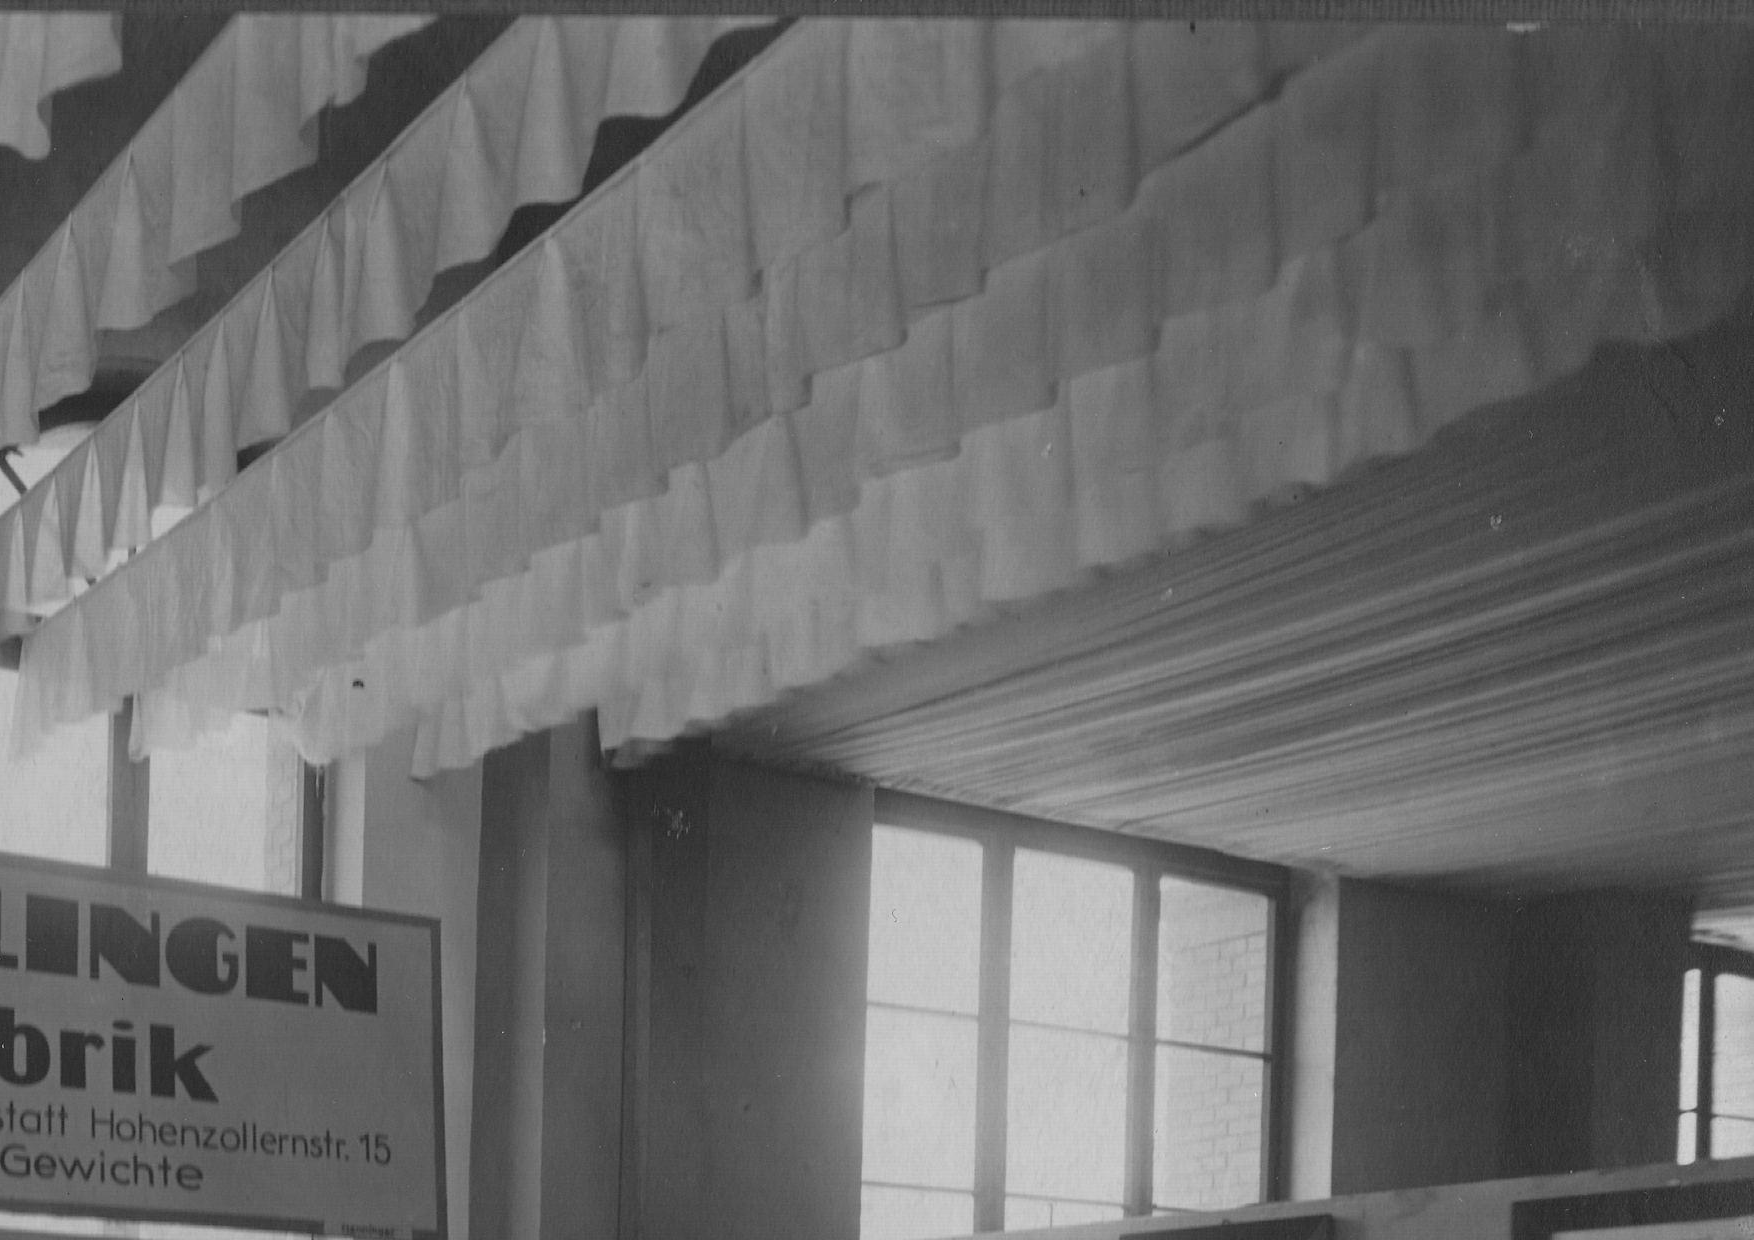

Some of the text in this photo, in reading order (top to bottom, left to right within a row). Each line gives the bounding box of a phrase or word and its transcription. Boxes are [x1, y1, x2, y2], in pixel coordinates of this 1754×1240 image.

[91, 1107, 350, 1162] Hohenzollernstr.
[359, 1132, 392, 1166] 15
[0, 1143, 205, 1192] Gewichte
